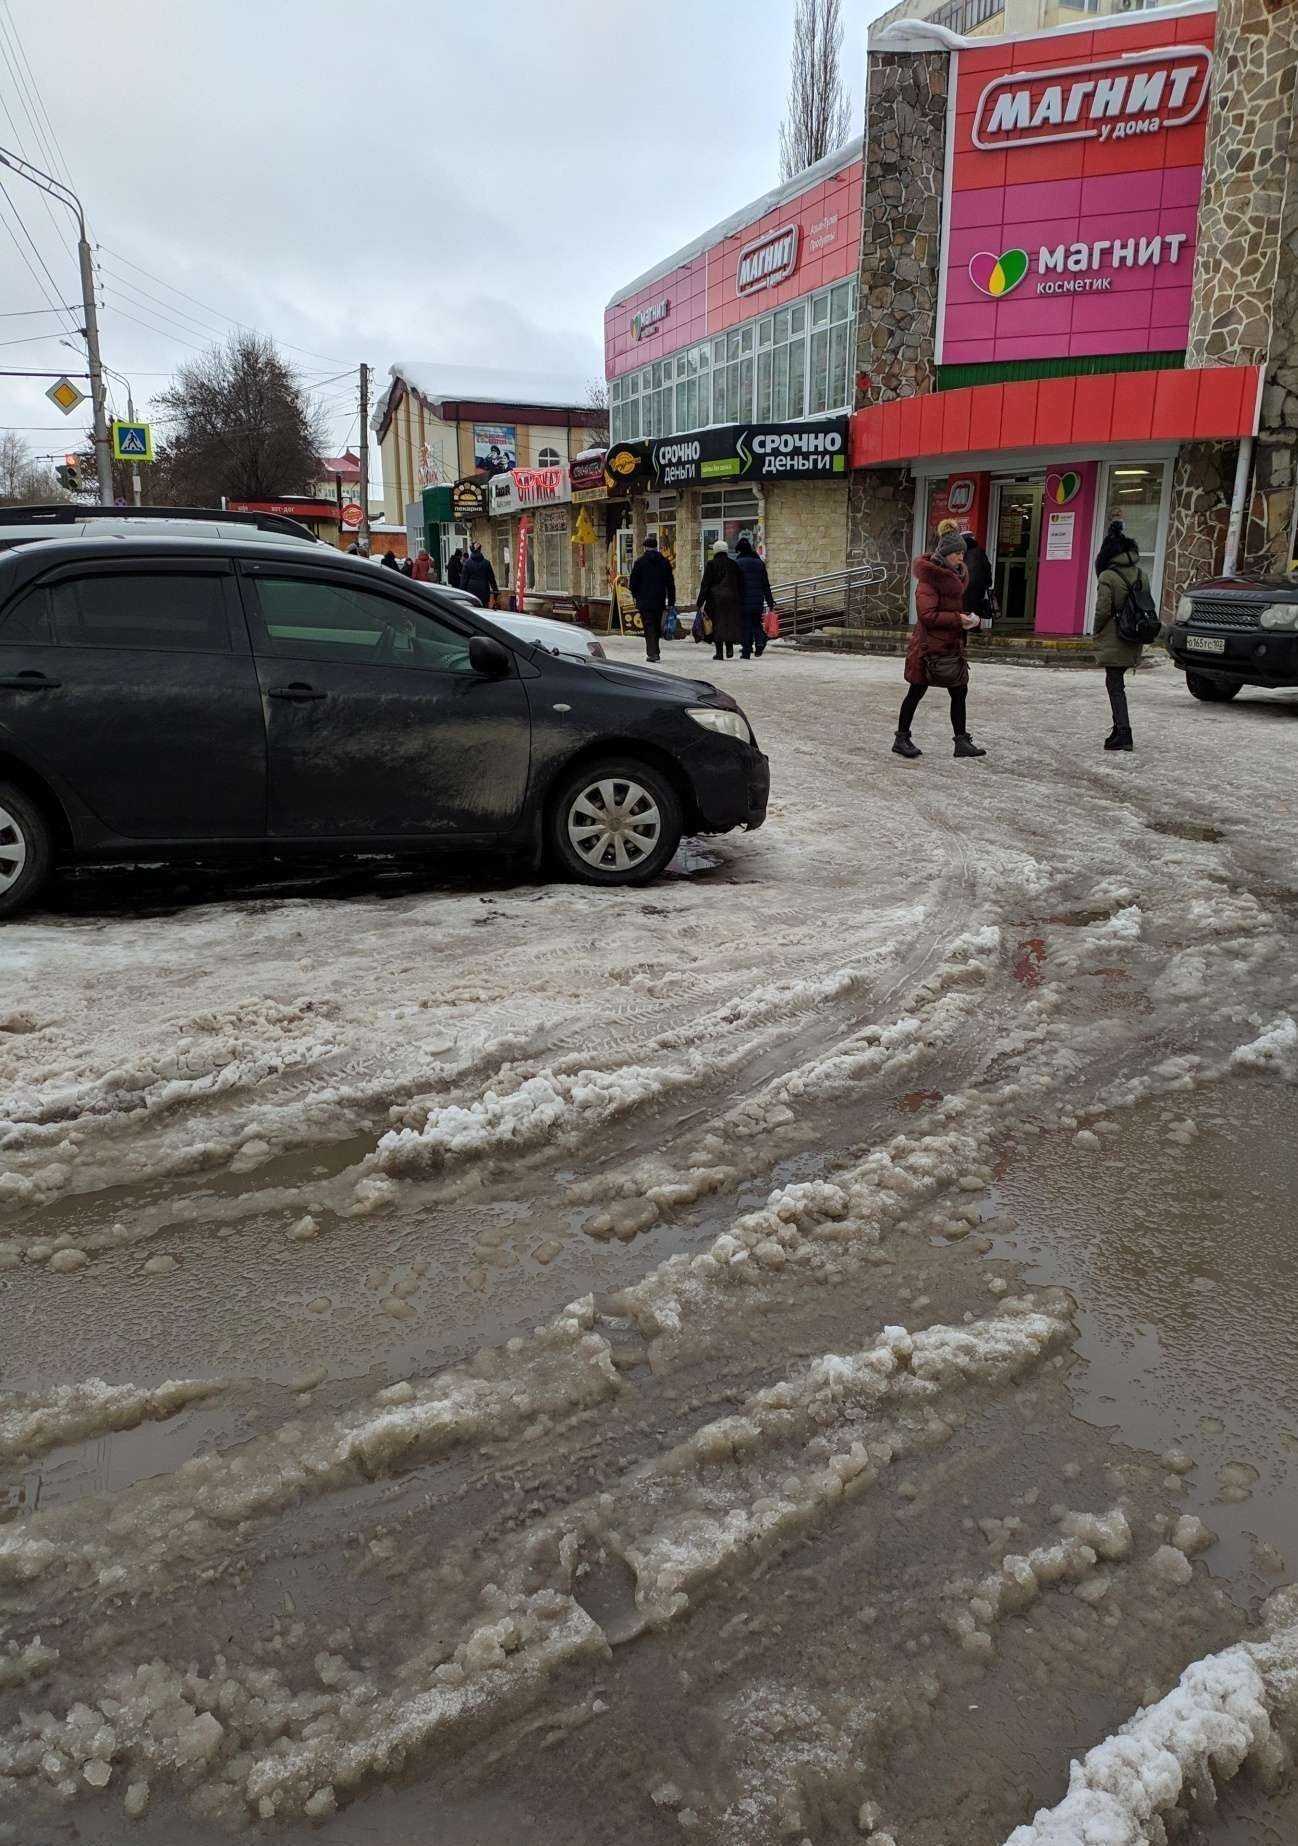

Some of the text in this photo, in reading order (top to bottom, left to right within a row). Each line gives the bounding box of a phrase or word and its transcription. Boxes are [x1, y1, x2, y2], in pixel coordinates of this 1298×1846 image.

[987, 65, 1199, 133] МАГНИТ
[1099, 117, 1160, 142] у дома
[740, 236, 791, 286] МАГНИТ
[1038, 233, 1187, 275] магнит
[1037, 275, 1111, 294] косметик
[659, 441, 700, 465] СРОЧНО
[752, 432, 842, 453] СРОЧНО
[762, 454, 830, 474] деньги
